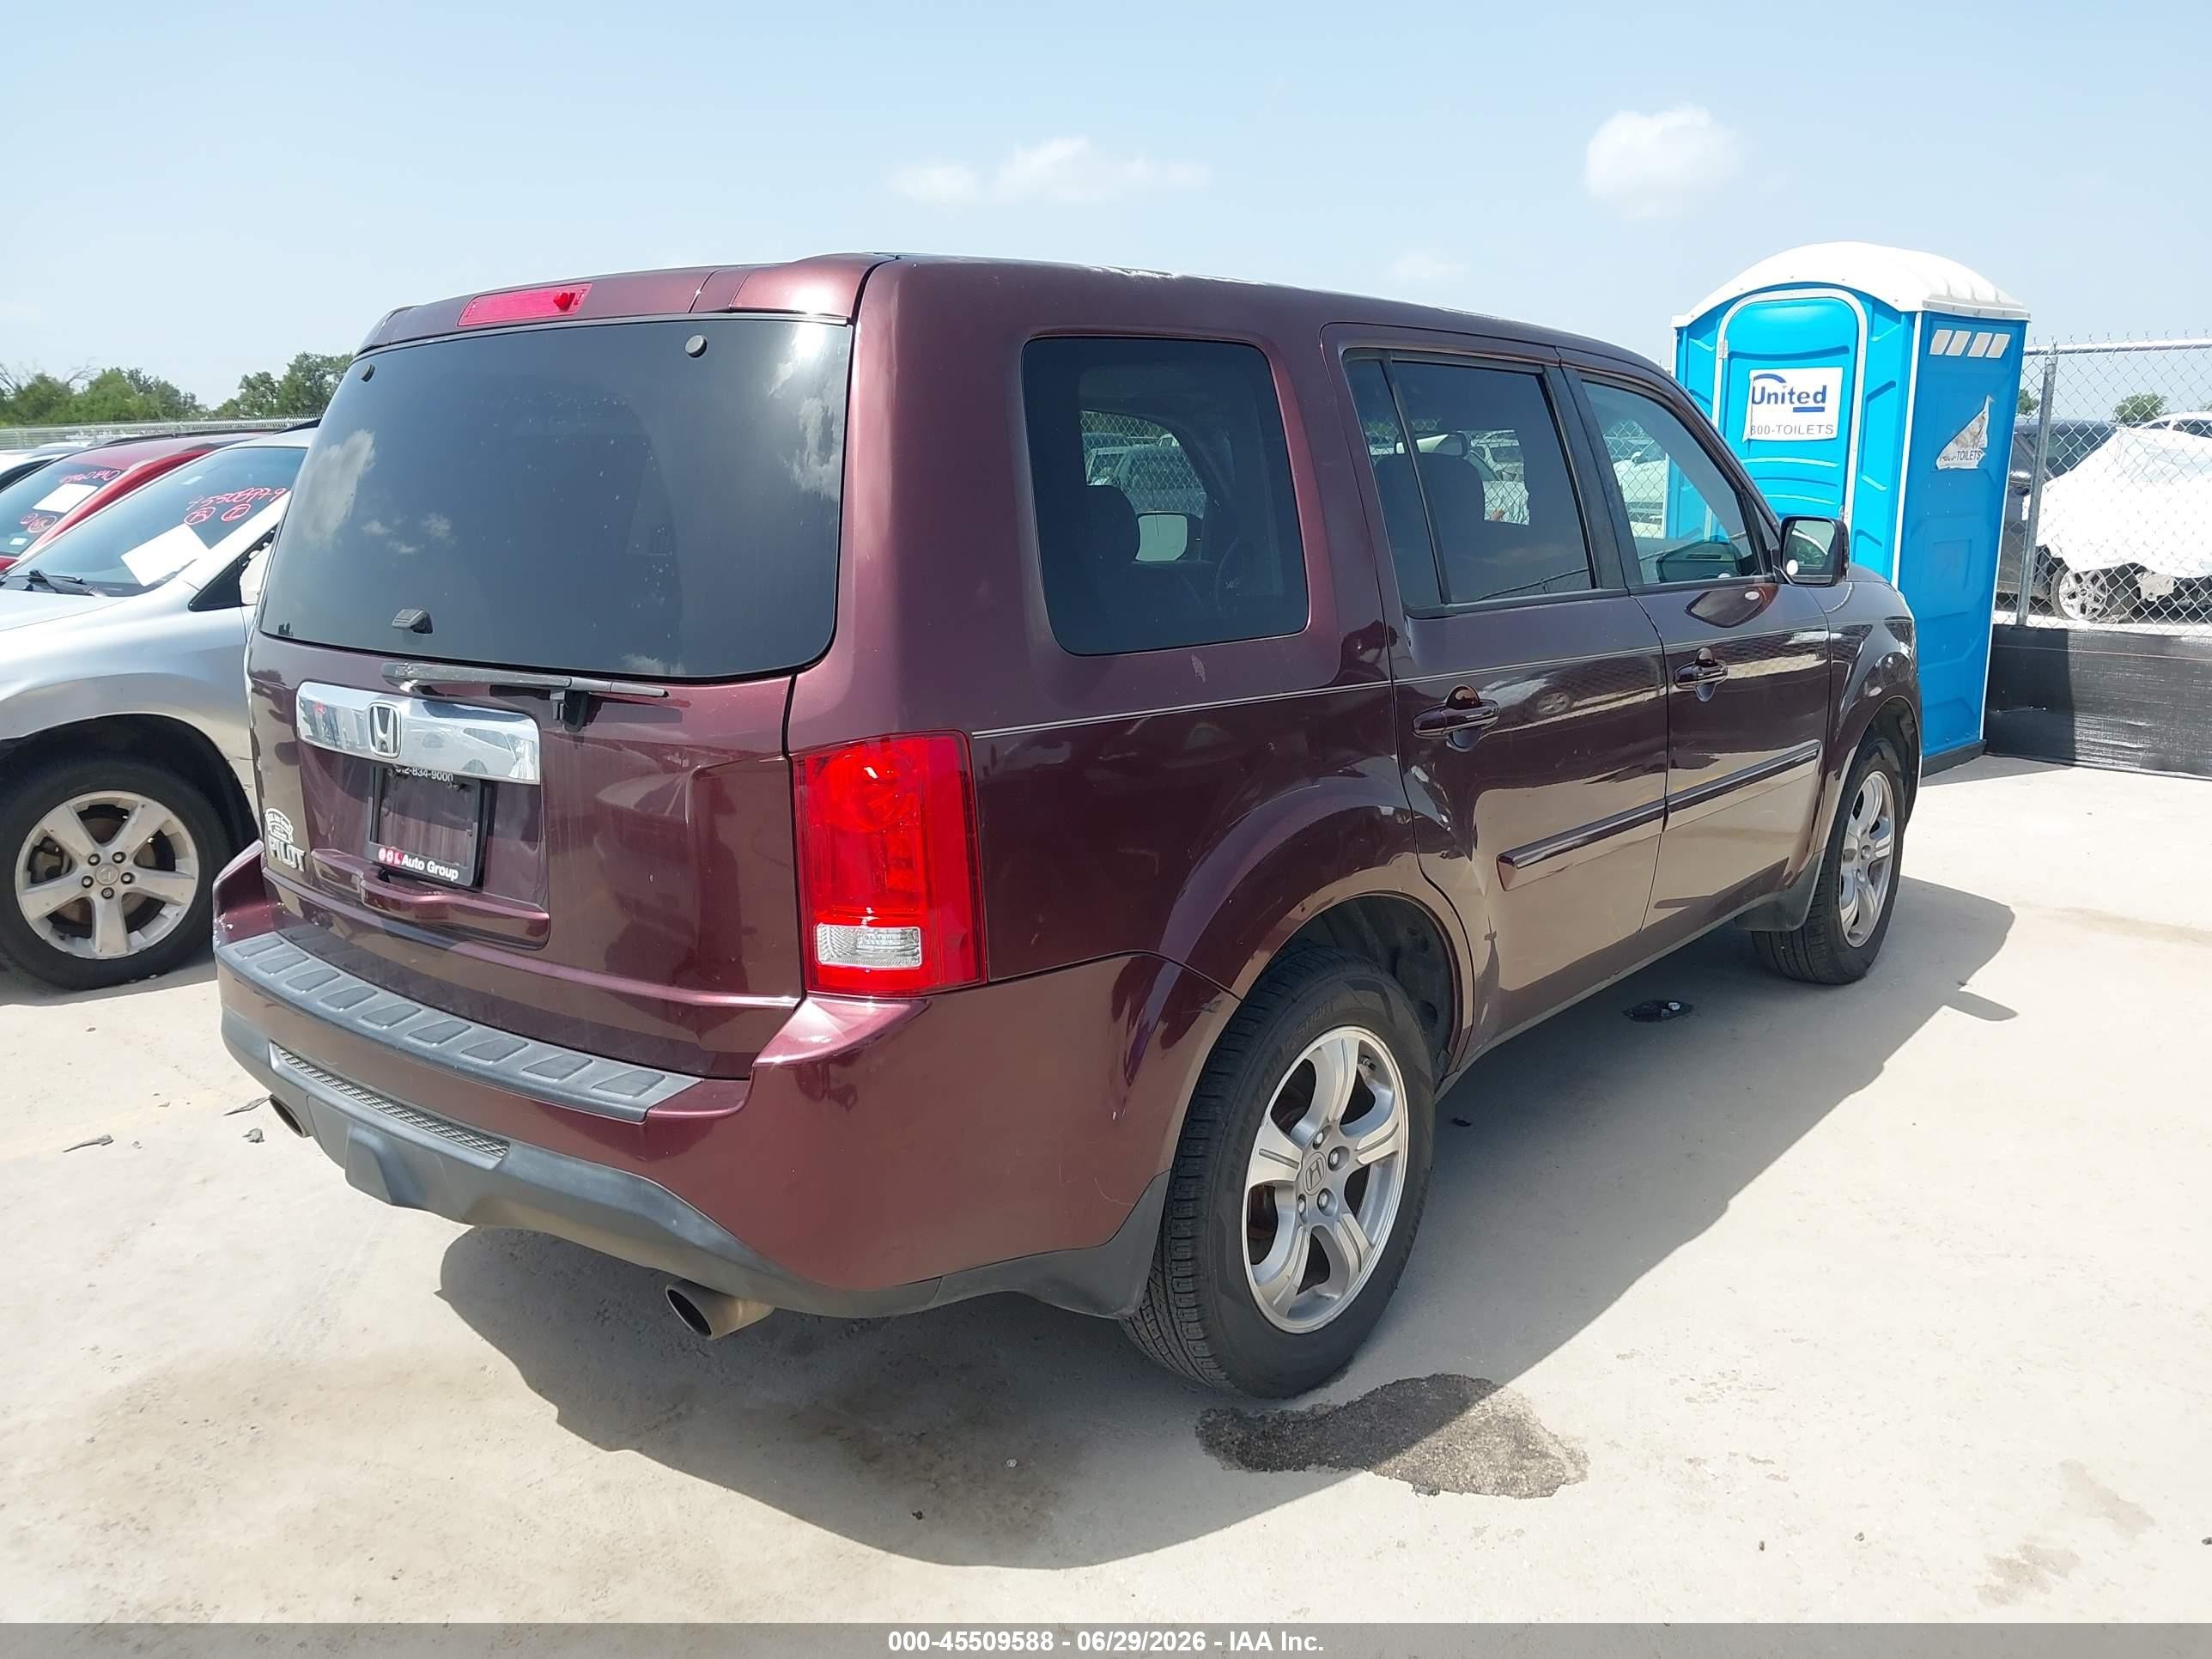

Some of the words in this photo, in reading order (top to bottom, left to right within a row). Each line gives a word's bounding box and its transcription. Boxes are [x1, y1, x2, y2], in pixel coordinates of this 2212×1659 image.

[1752, 385, 1827, 404] United
[268, 836, 307, 872] PILOT
[401, 854, 425, 871] Auto
[427, 860, 459, 881] Group
